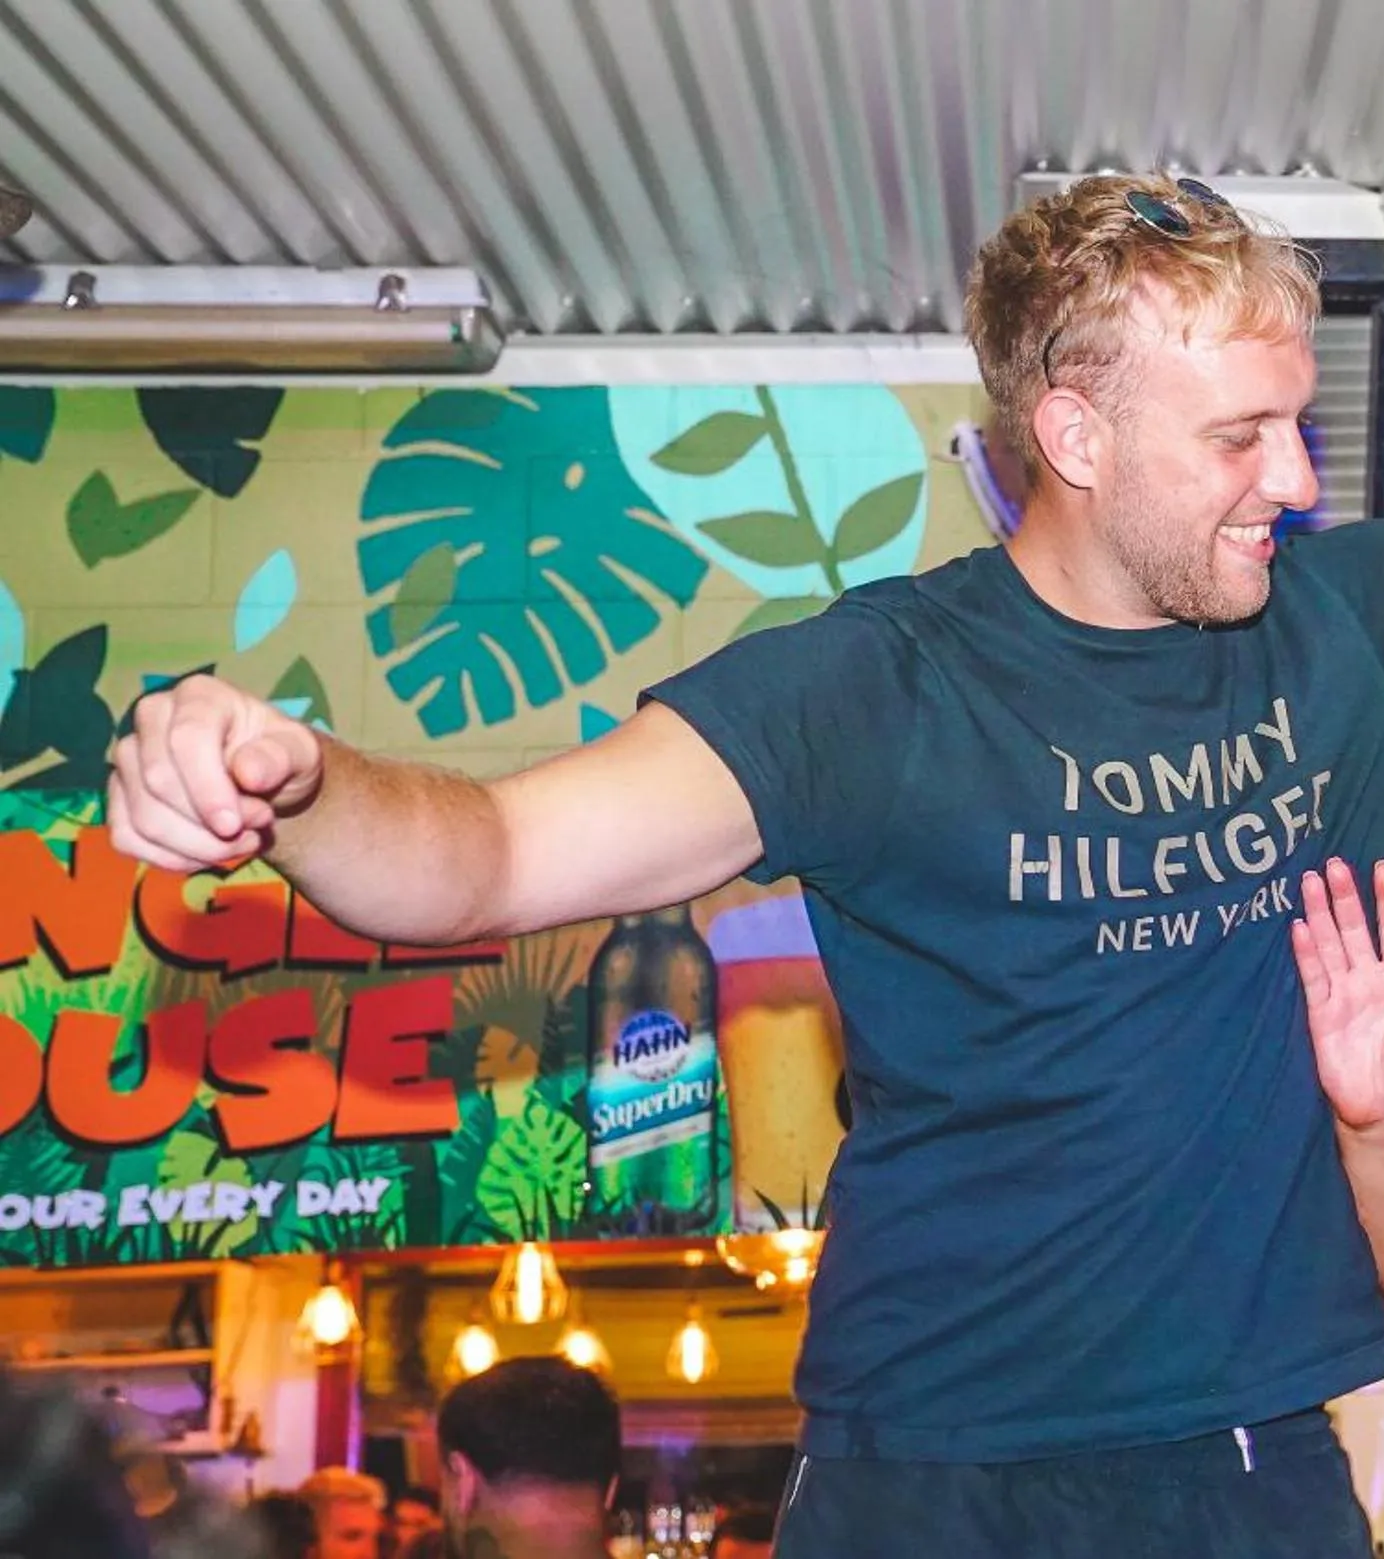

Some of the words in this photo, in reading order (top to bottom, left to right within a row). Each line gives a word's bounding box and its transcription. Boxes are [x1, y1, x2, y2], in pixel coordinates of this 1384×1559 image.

[1097, 911, 1200, 954] NEW
[1217, 877, 1293, 937] YRK
[613, 1024, 691, 1067] HAHN
[117, 1180, 284, 1227] EVERY
[296, 1176, 391, 1217] DAY
